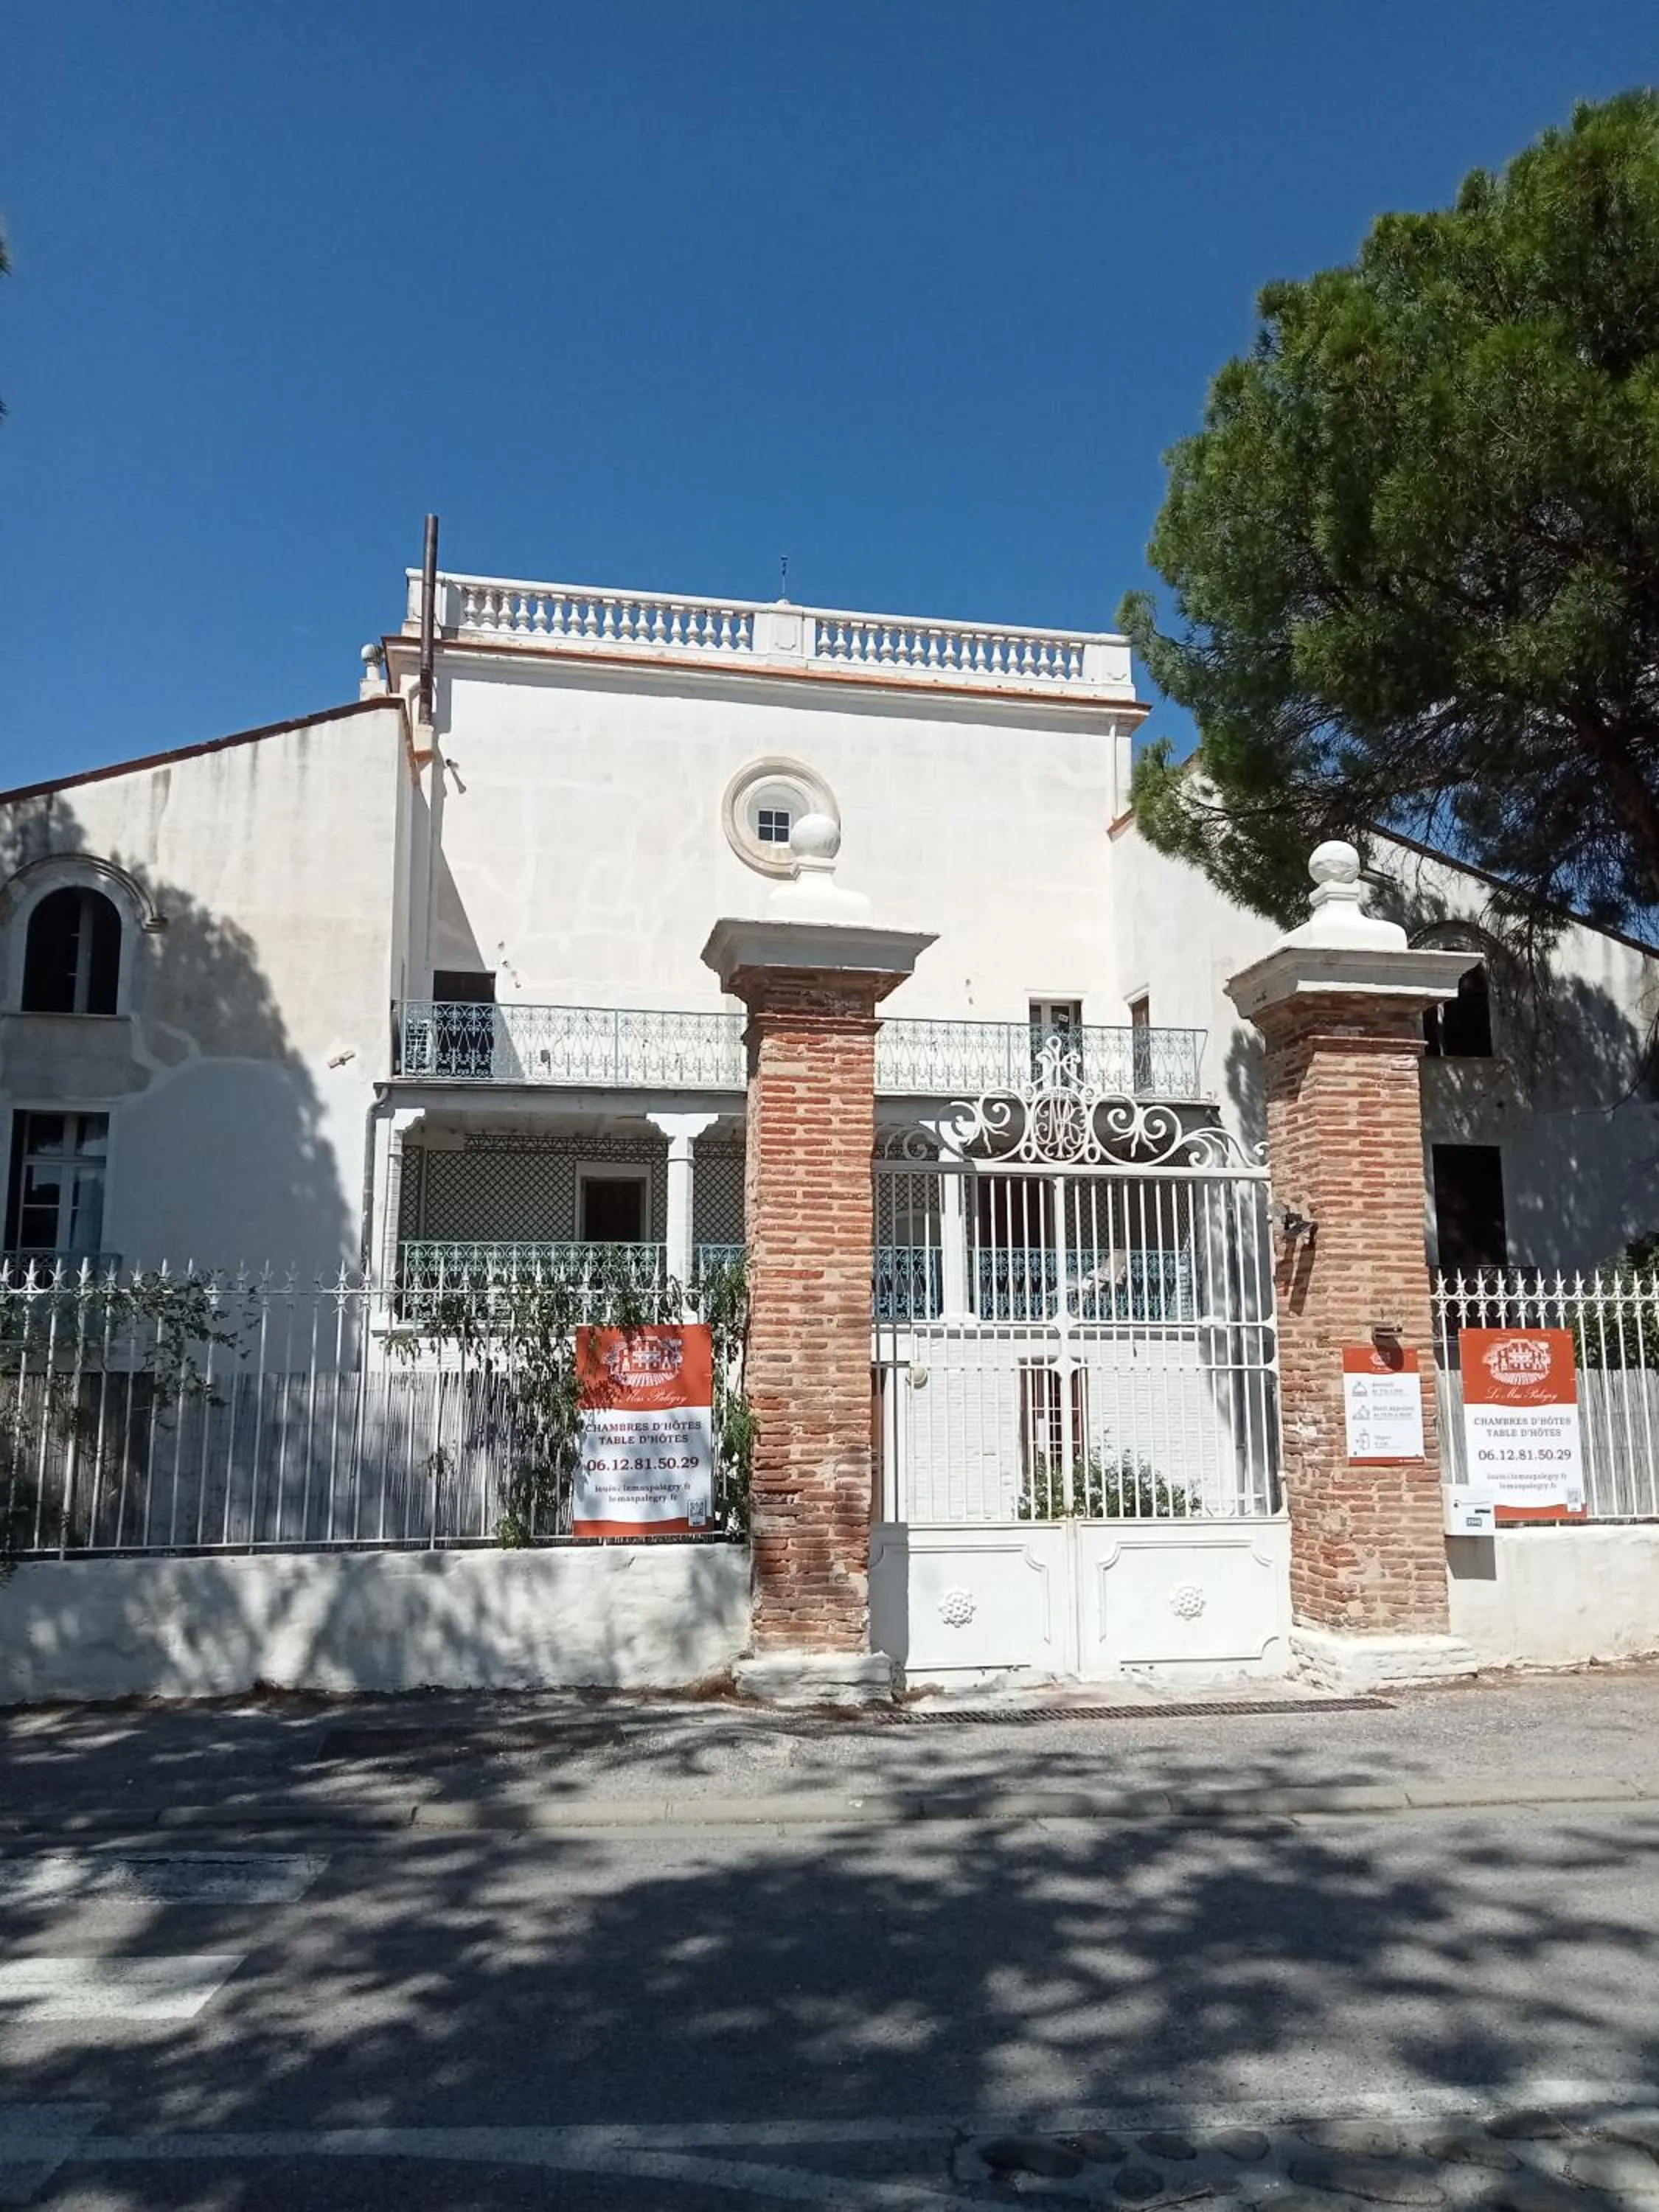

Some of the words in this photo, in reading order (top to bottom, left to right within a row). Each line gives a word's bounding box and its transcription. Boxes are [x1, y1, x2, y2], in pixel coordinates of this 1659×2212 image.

[585, 1422, 649, 1433] CHAMBRES
[653, 1419, 701, 1431] D'HÔTES
[1474, 1416, 1528, 1425] CHAMBRES
[1531, 1415, 1571, 1425] D'HÔTES
[1486, 1429, 1518, 1437] TABLE
[1520, 1427, 1562, 1437] D'HÔTES
[599, 1436, 635, 1445] TABLE
[639, 1433, 689, 1444] D'HÔTES
[1478, 1449, 1571, 1461] 06.12.81.50.29
[587, 1456, 699, 1471] 06.12.81.50.29
